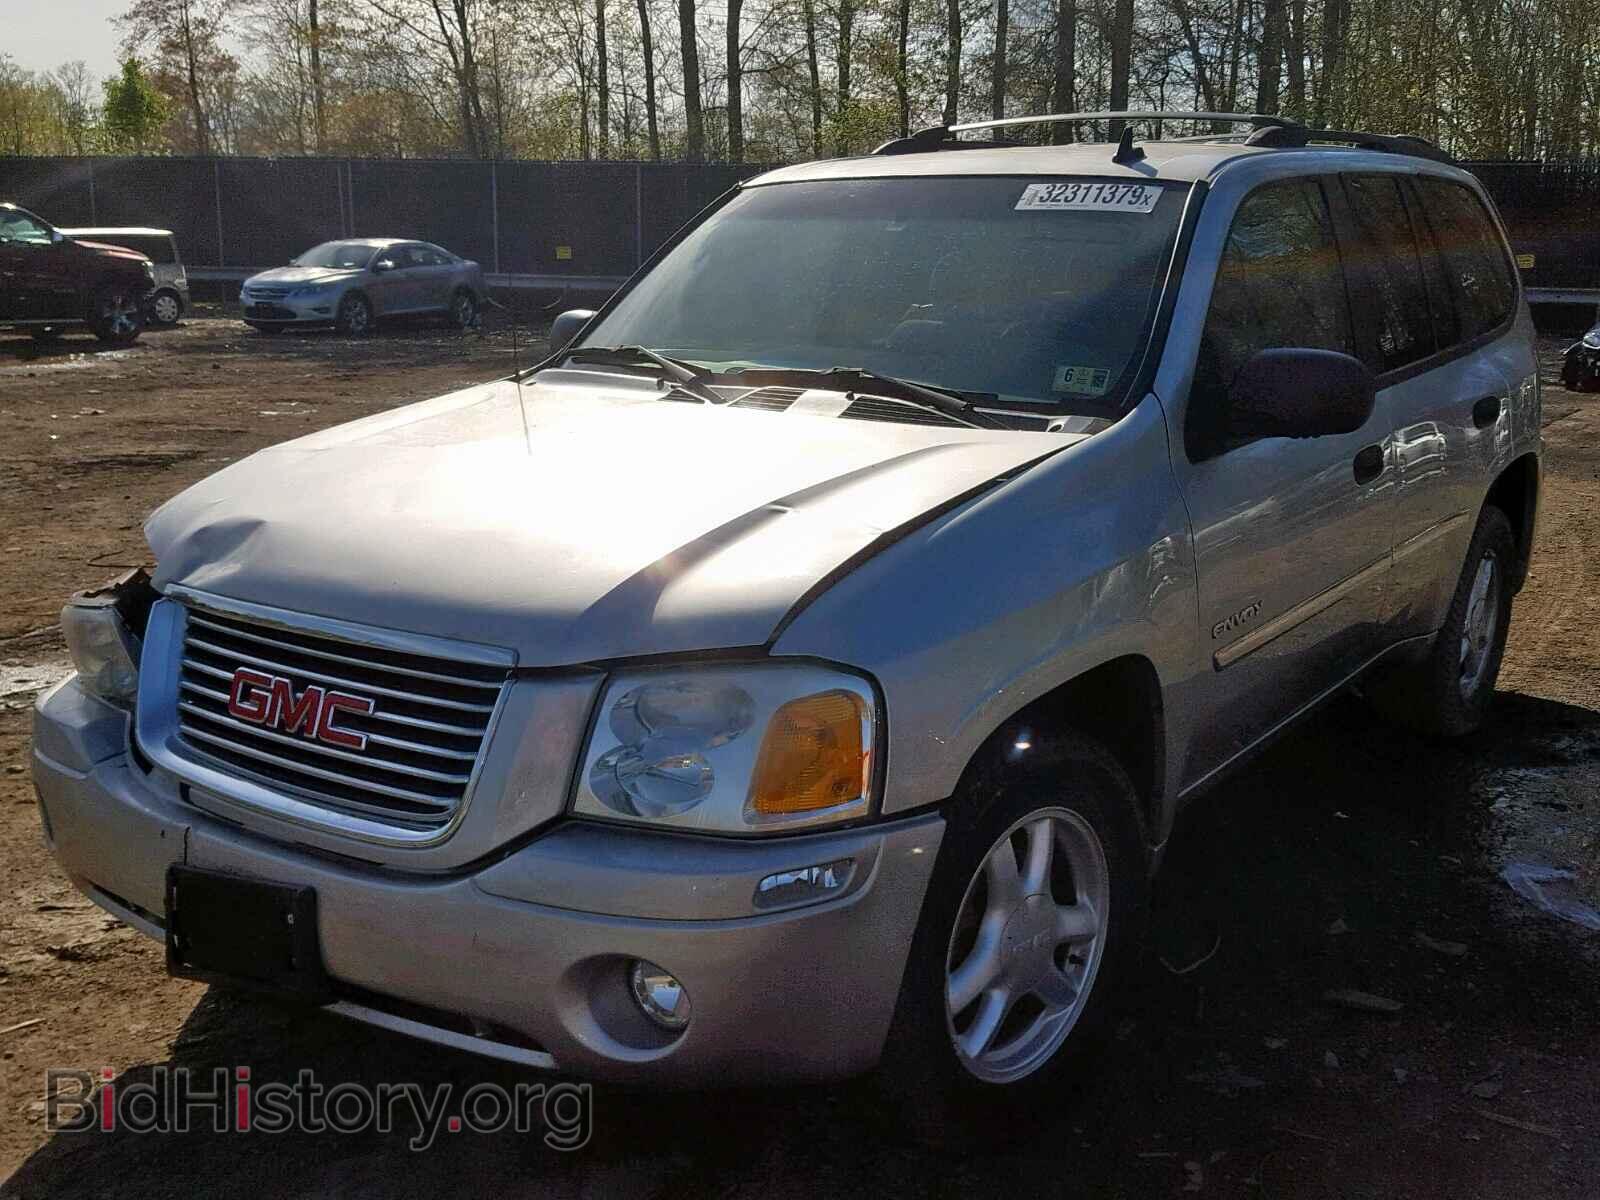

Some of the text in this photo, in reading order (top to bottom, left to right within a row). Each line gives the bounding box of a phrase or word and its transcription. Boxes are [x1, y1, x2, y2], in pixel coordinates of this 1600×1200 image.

[1064, 368, 1074, 382] 6
[1211, 600, 1263, 639] ENVOY
[228, 667, 375, 750] GMC
